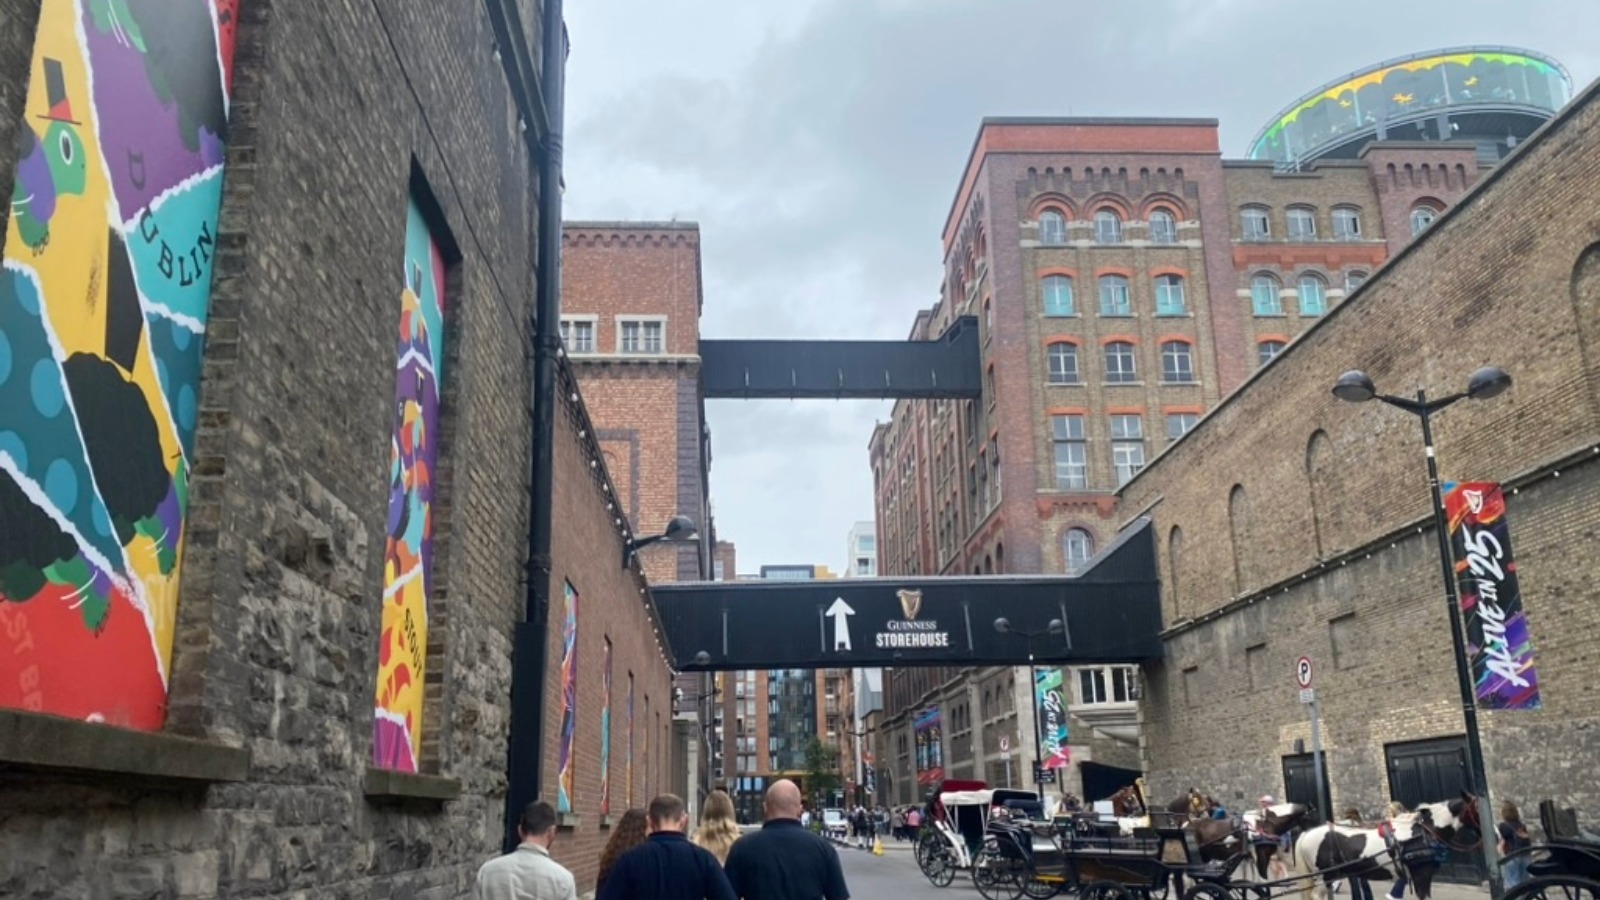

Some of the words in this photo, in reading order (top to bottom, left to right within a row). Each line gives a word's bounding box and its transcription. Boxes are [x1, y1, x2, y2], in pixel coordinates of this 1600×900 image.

[1476, 578, 1498, 601] IN
[887, 620, 937, 631] GUINNESS
[404, 607, 422, 680] STOUT
[876, 632, 949, 647] STOREHOUSE
[1476, 600, 1530, 687] ALIVE
[1301, 662, 1309, 683] P
